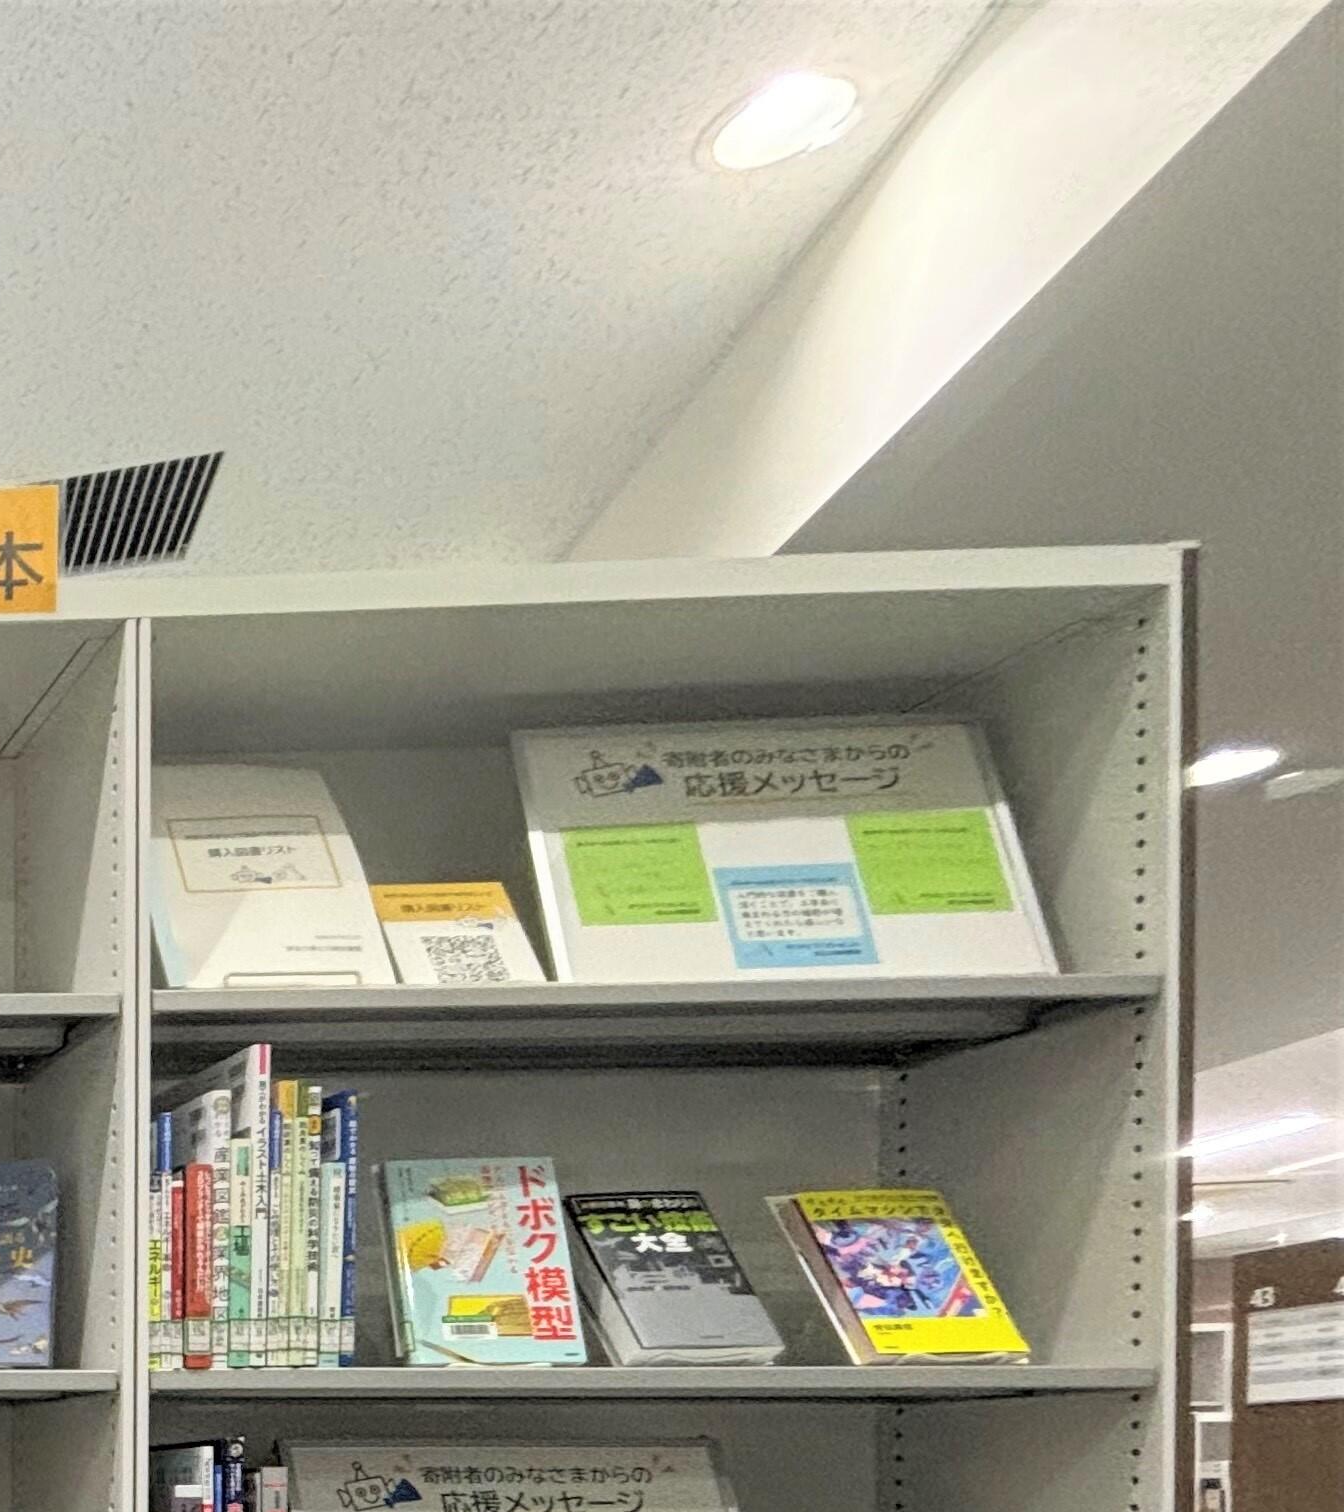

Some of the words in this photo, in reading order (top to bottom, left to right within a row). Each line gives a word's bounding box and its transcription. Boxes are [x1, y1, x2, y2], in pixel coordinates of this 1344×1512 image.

[661, 743, 909, 767] 寄附者のみなさまからの
[685, 767, 900, 798] 応援メッセージ
[516, 1164, 577, 1341] ドボク模型
[420, 1465, 652, 1485] 寄附者のみなさまからの
